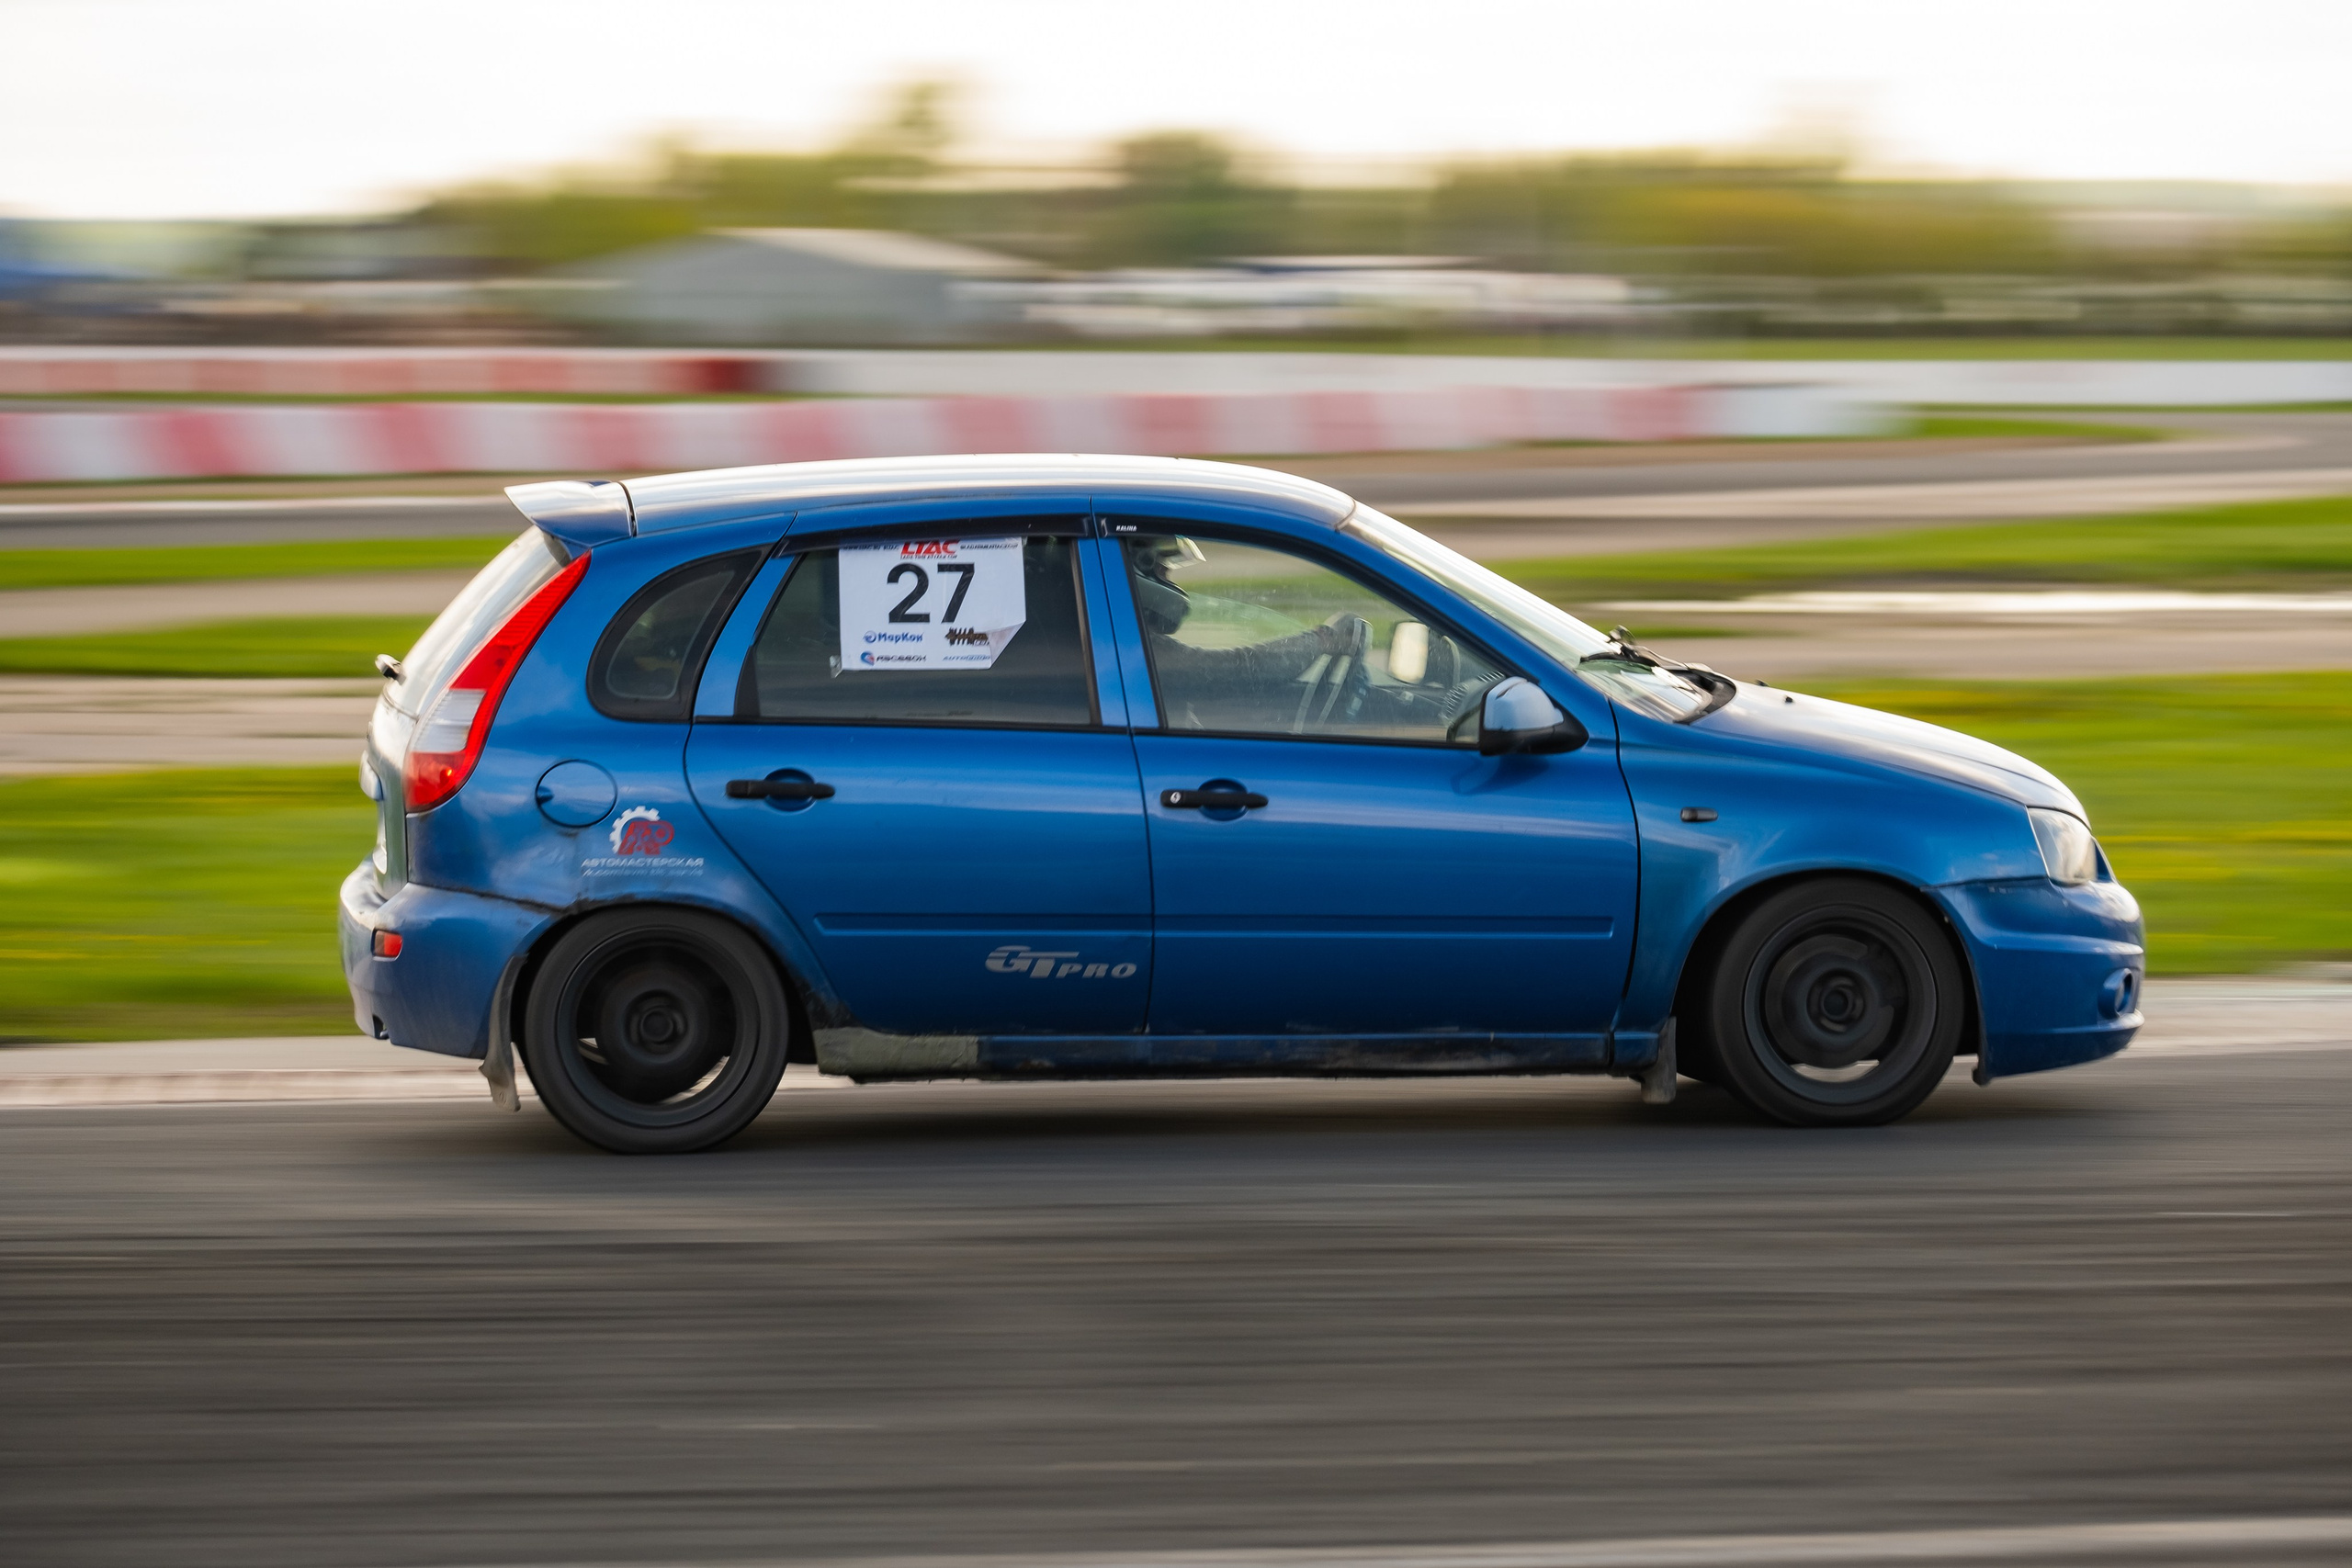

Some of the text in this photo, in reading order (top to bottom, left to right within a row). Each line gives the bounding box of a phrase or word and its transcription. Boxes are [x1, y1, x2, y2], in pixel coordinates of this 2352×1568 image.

[900, 539, 960, 555] LTAC
[887, 562, 976, 624] 27
[581, 857, 705, 868] АВТОМАСТЕРСКАЯ
